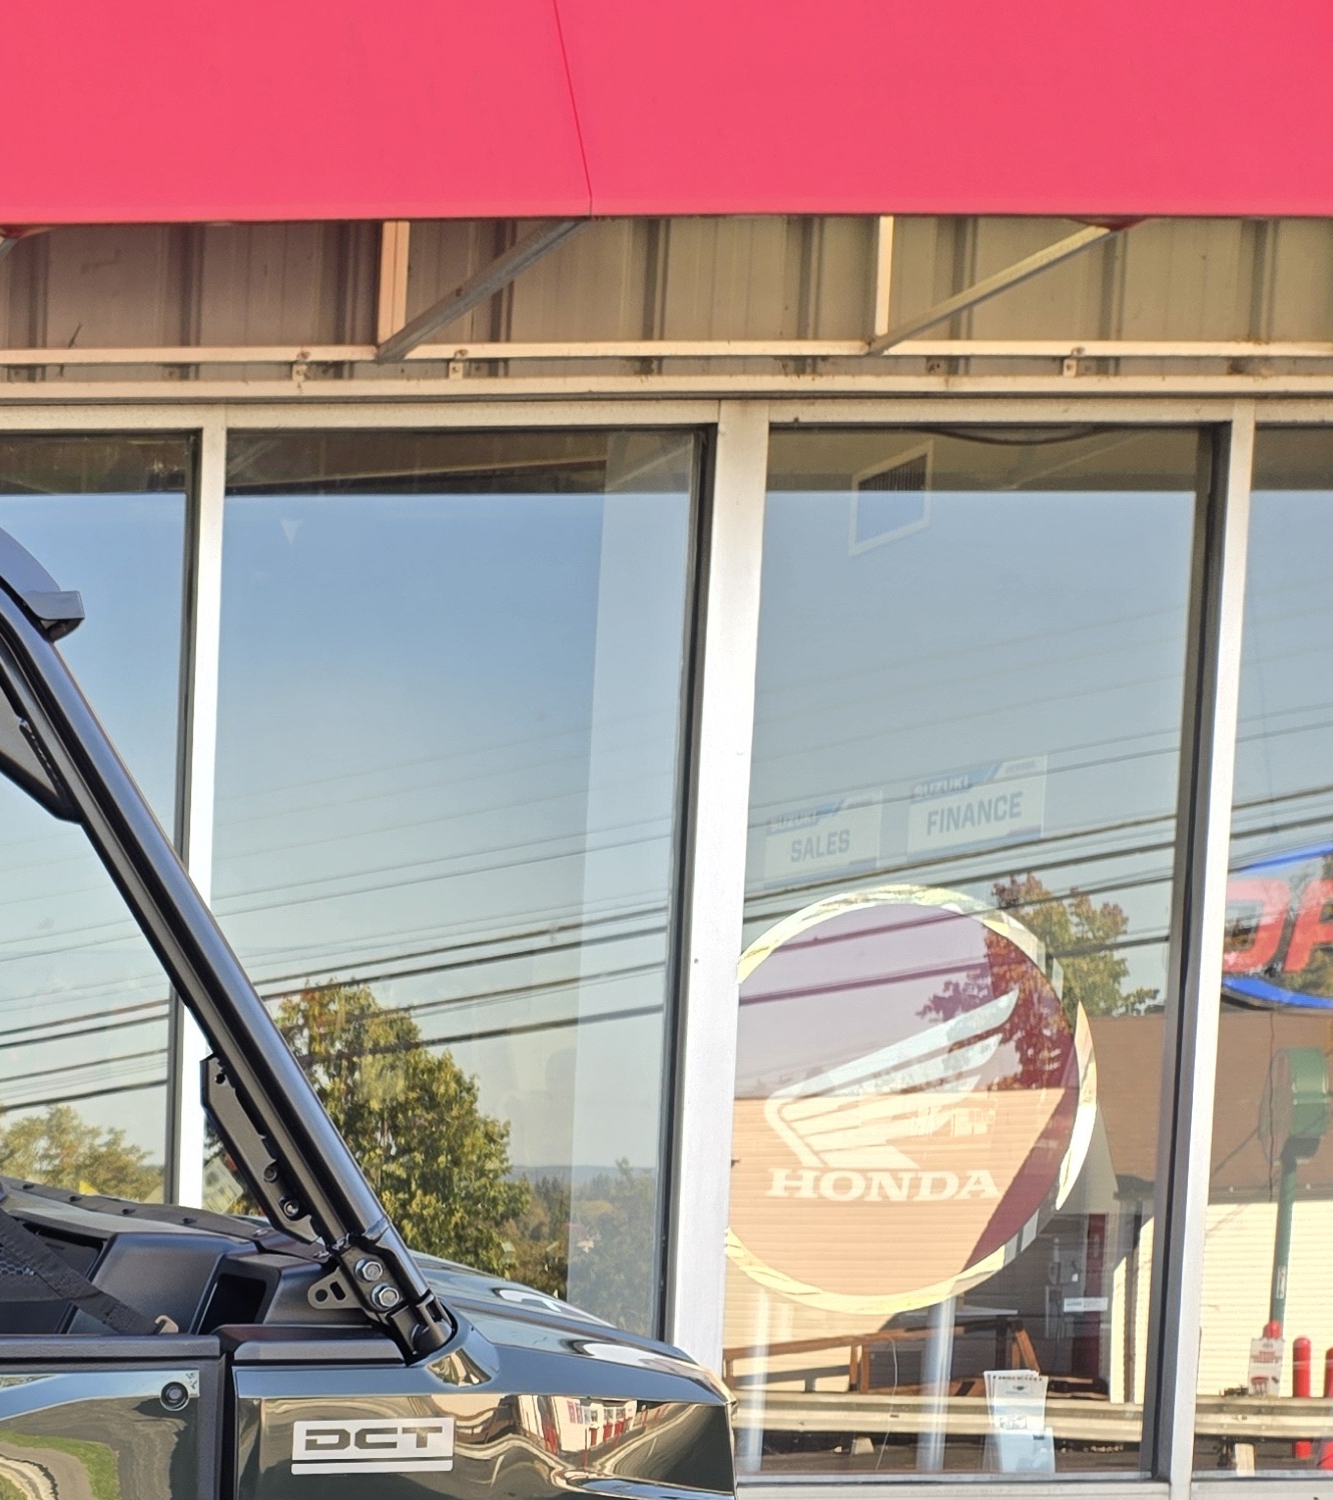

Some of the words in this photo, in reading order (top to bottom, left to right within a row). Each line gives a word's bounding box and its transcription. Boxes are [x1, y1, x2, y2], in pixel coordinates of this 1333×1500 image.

[927, 791, 1023, 836] FINANCE
[791, 829, 850, 863] SALES
[765, 1167, 1001, 1201] HONDA
[305, 1426, 442, 1451] DCT
